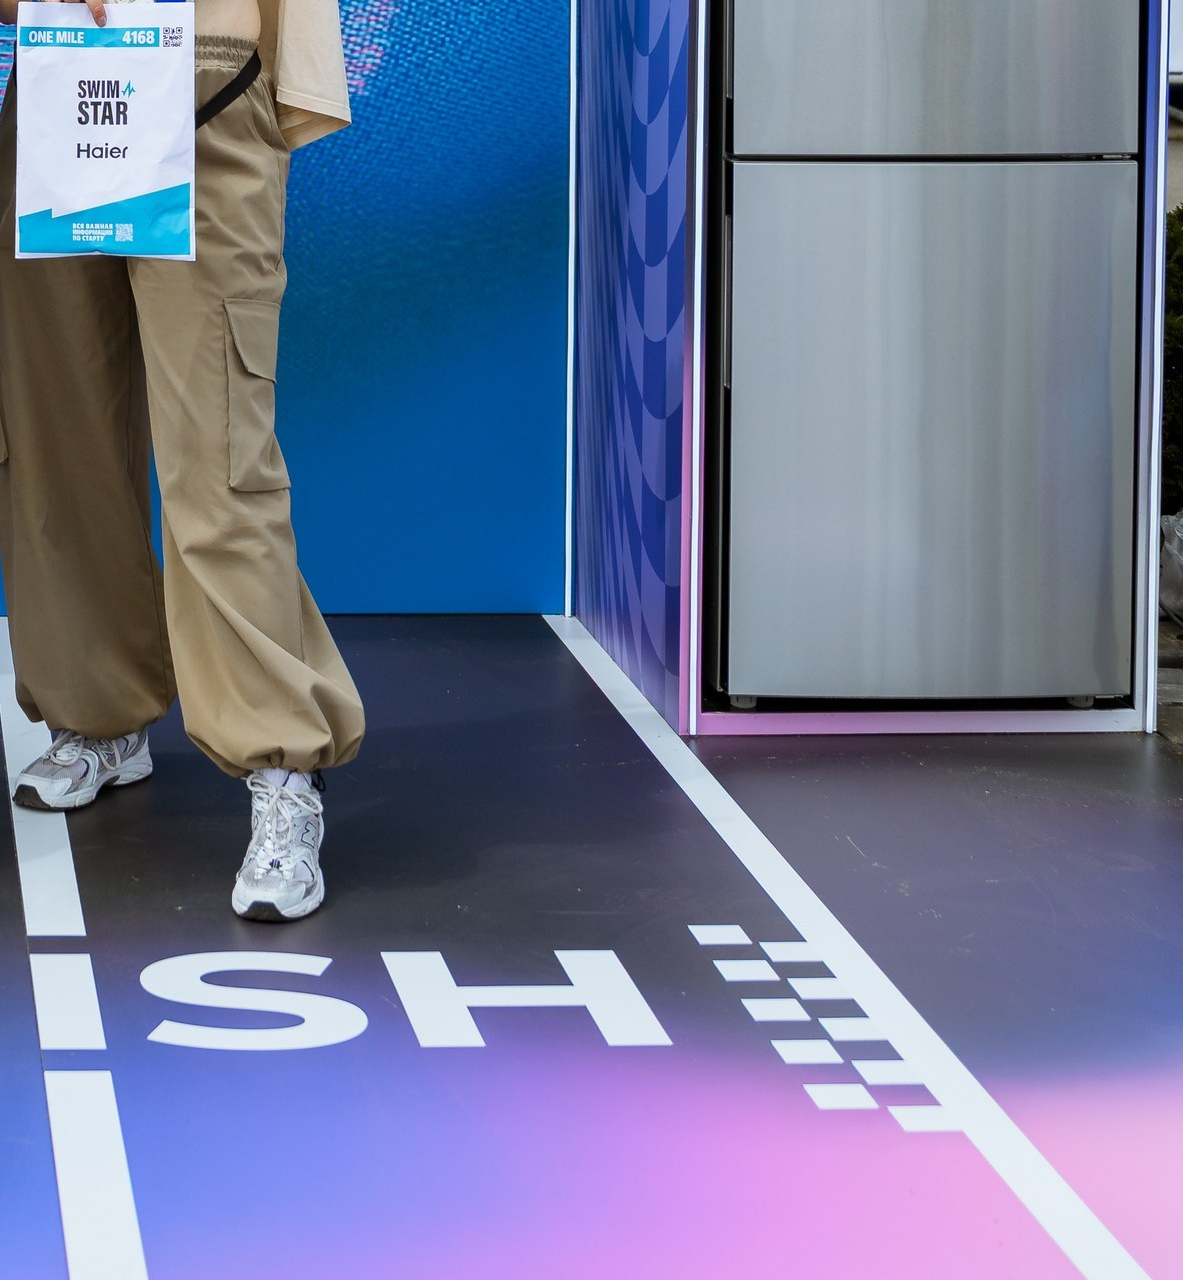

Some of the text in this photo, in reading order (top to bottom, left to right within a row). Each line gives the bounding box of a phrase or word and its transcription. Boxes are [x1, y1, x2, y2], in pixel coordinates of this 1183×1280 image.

[28, 30, 155, 44] ONE MILE 4168
[77, 79, 120, 99] SWIM
[77, 100, 128, 125] STAR
[76, 142, 129, 159] Haier
